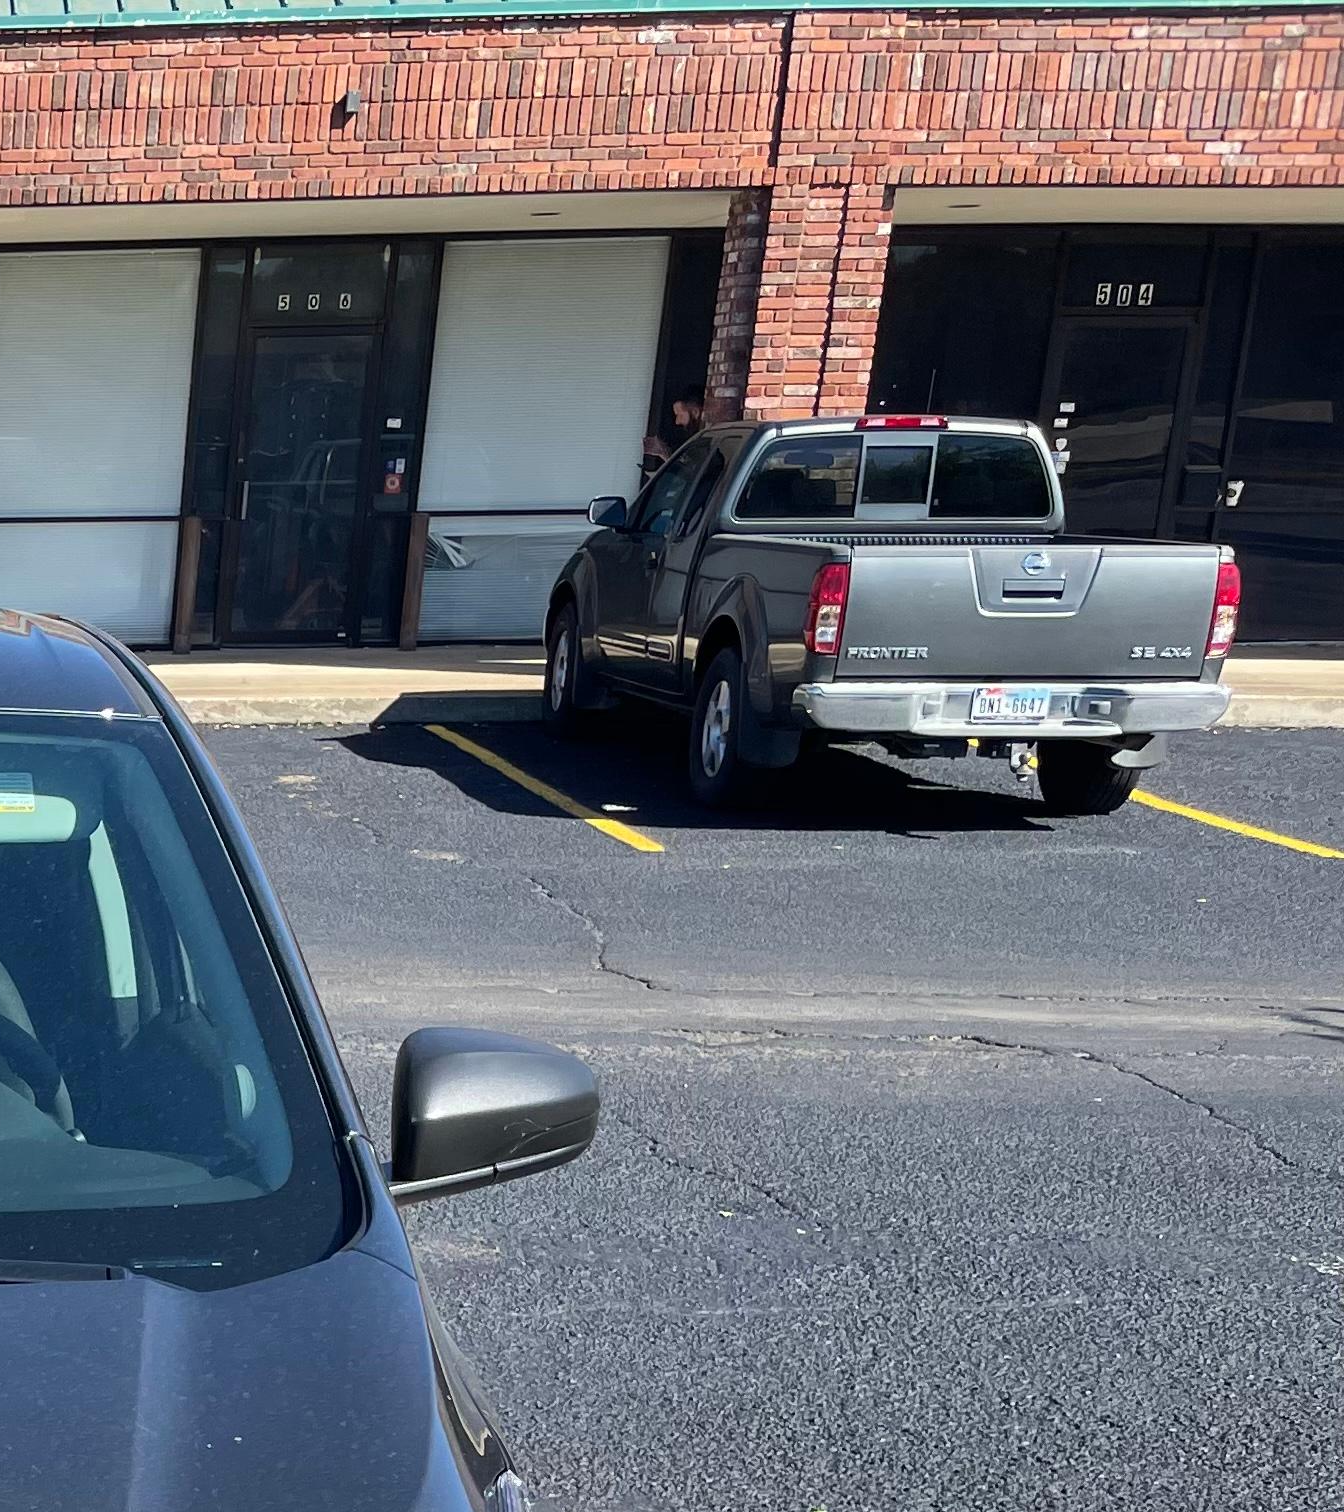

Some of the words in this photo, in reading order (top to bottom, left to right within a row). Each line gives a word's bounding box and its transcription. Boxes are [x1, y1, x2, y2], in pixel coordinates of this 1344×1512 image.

[1096, 283, 1154, 307] 504
[847, 646, 929, 659] FRONTIER
[1130, 646, 1156, 659] SE
